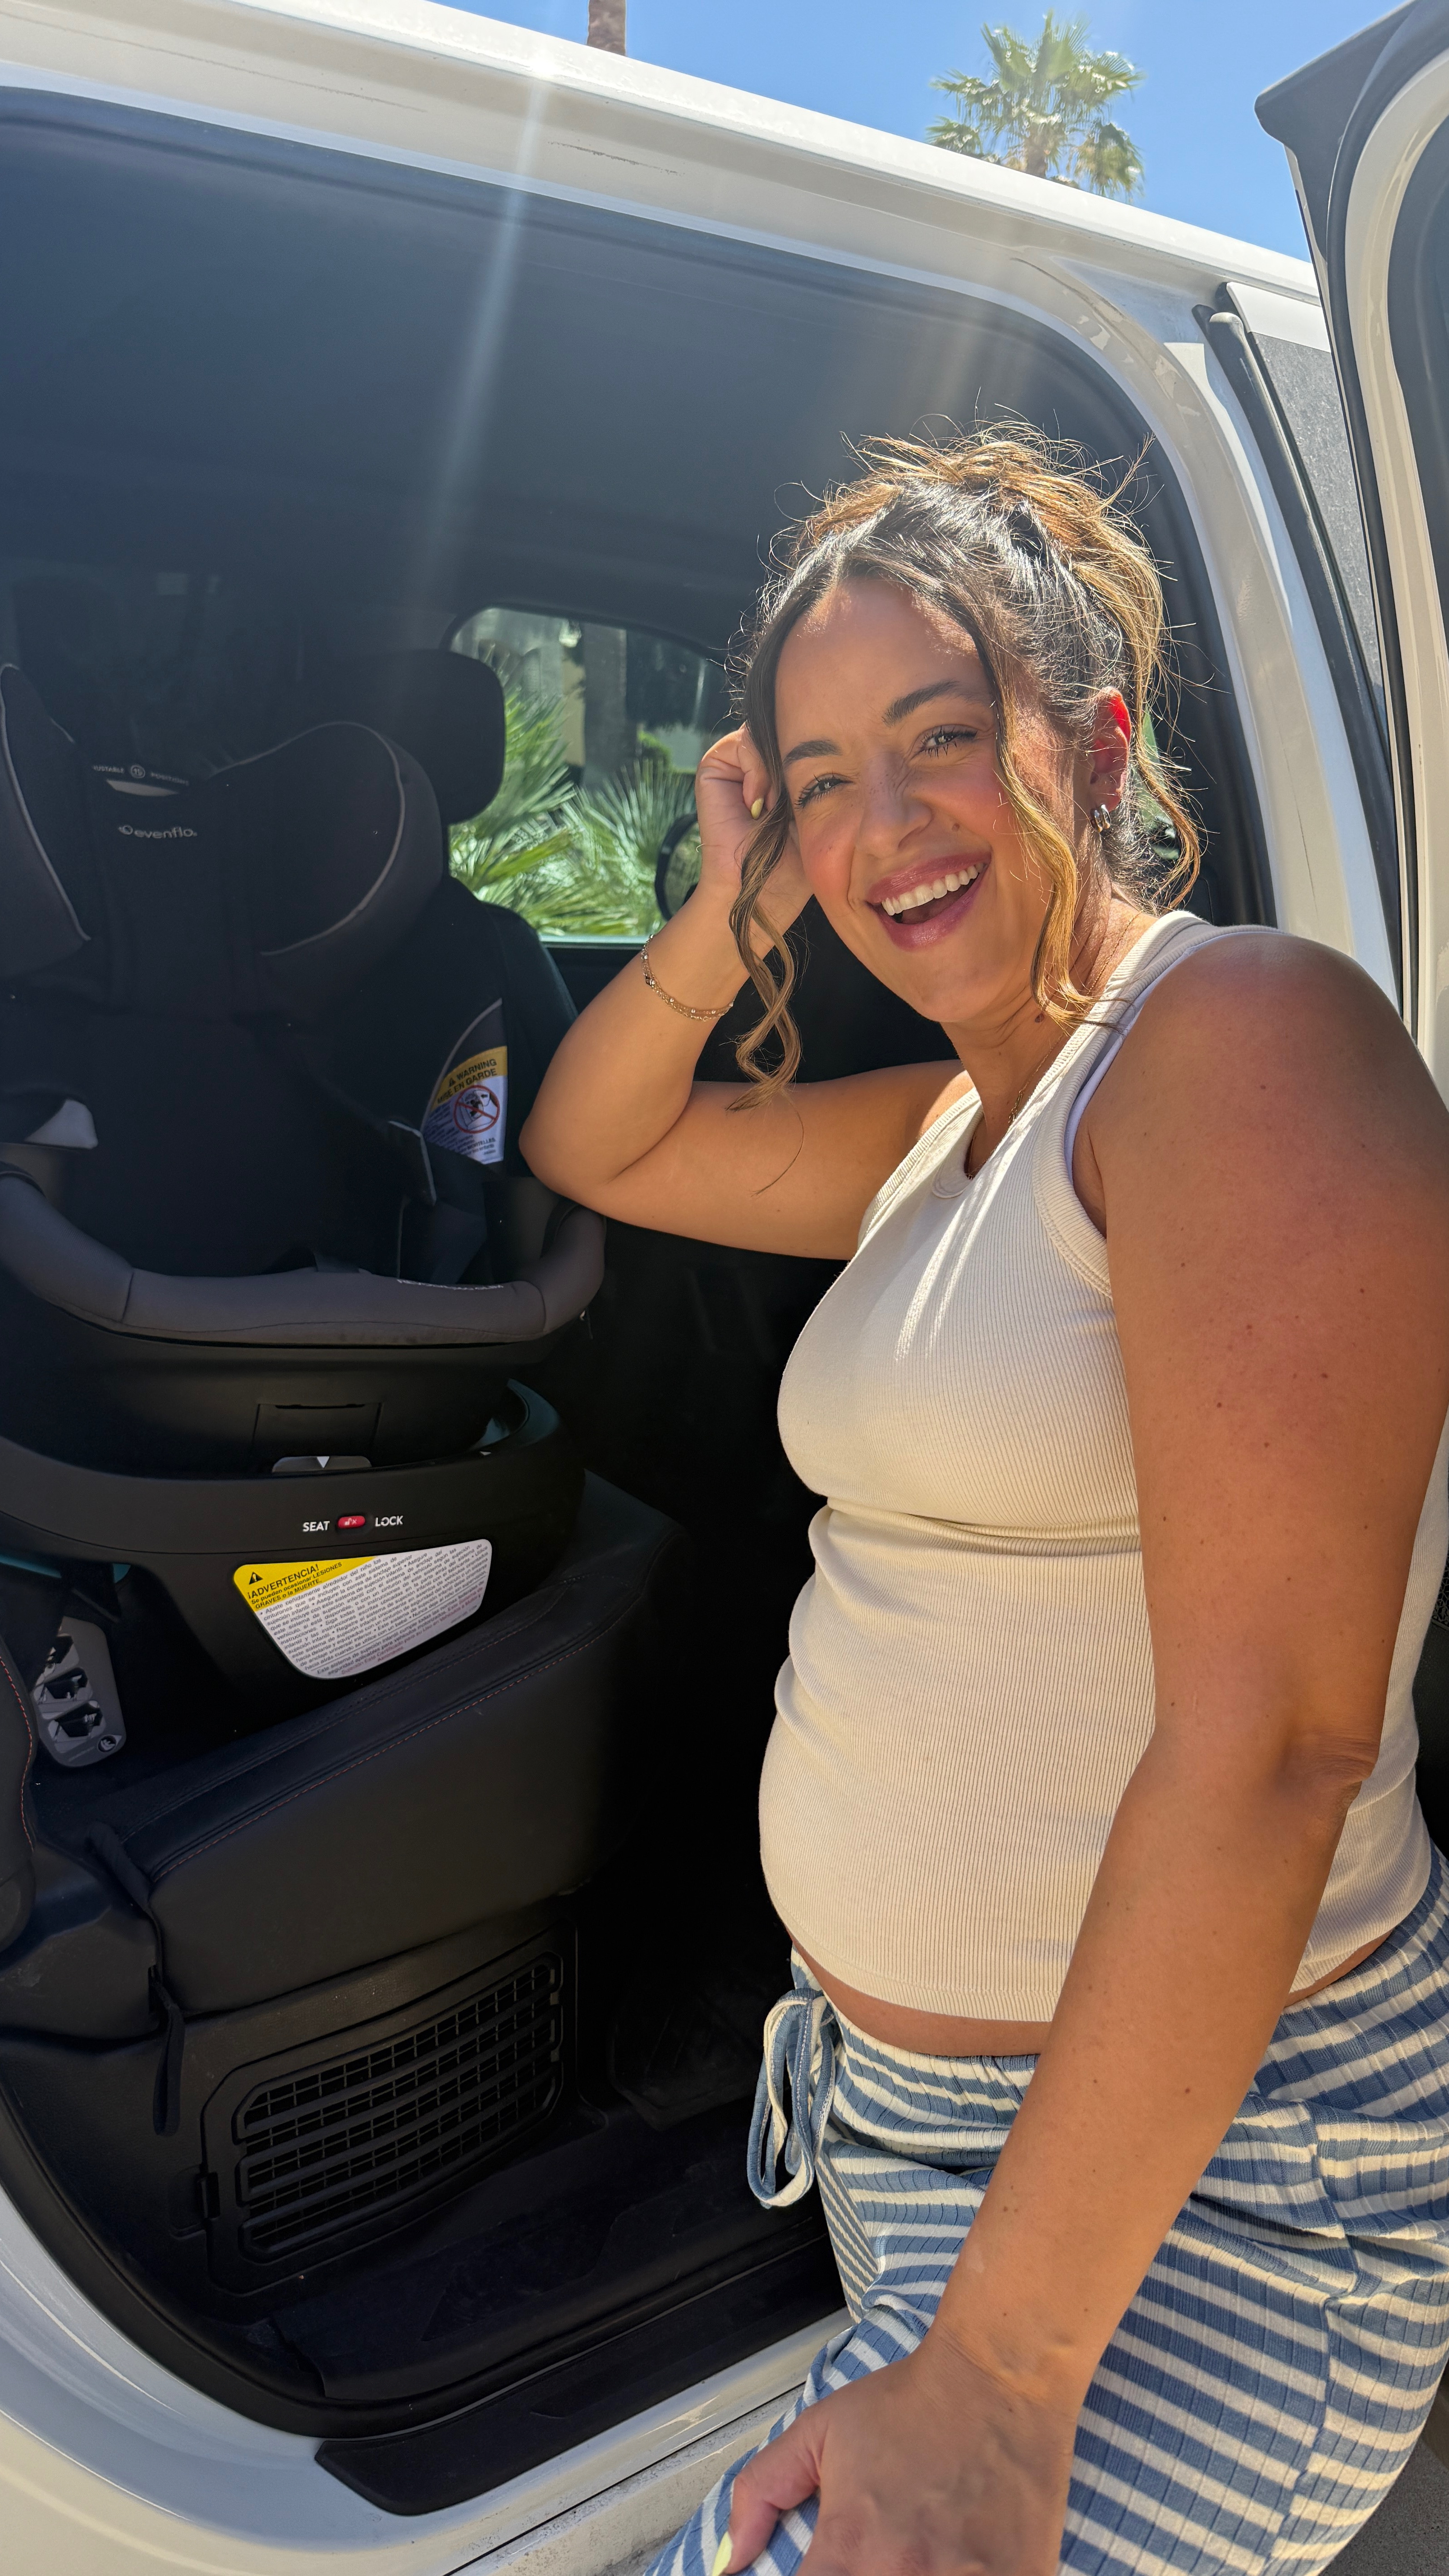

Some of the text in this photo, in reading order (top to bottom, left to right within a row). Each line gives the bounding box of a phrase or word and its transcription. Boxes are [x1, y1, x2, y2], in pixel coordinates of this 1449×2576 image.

[134, 826, 194, 838] evenflo
[437, 1068, 497, 1104] MISE EN GARDE
[457, 1059, 497, 1080] WARNING
[303, 1515, 404, 1532] SEAT LOCK
[248, 1563, 319, 1600] ¡ADVERTENCIA!
[255, 1594, 281, 1609] GRAVES
[294, 1578, 322, 1592] MUERTE.
[260, 1588, 282, 1601] pueden
[283, 1575, 311, 1591] ocasionar
[312, 1562, 342, 1578] LESIONES
[265, 1604, 283, 1614] Ajuste
[322, 1574, 348, 1589] alrededor
[270, 1623, 281, 1632] que
[290, 1611, 309, 1622] incluye
[322, 1600, 334, 1608] este
[335, 1590, 355, 1602] sistema
[408, 1553, 428, 1566] Asegure
[289, 1617, 310, 1629] sistema
[347, 1591, 364, 1603] infantil
[385, 1571, 405, 1584] sistema
[291, 1604, 310, 1615] infantil
[316, 1592, 339, 1605] Asegure
[346, 1580, 364, 1591] correa
[373, 1566, 391, 1578] anclaje
[392, 1555, 413, 1568] superior
[295, 1600, 306, 1609] que
[317, 1585, 340, 1598] incluyen
[368, 1561, 388, 1574] sistema
